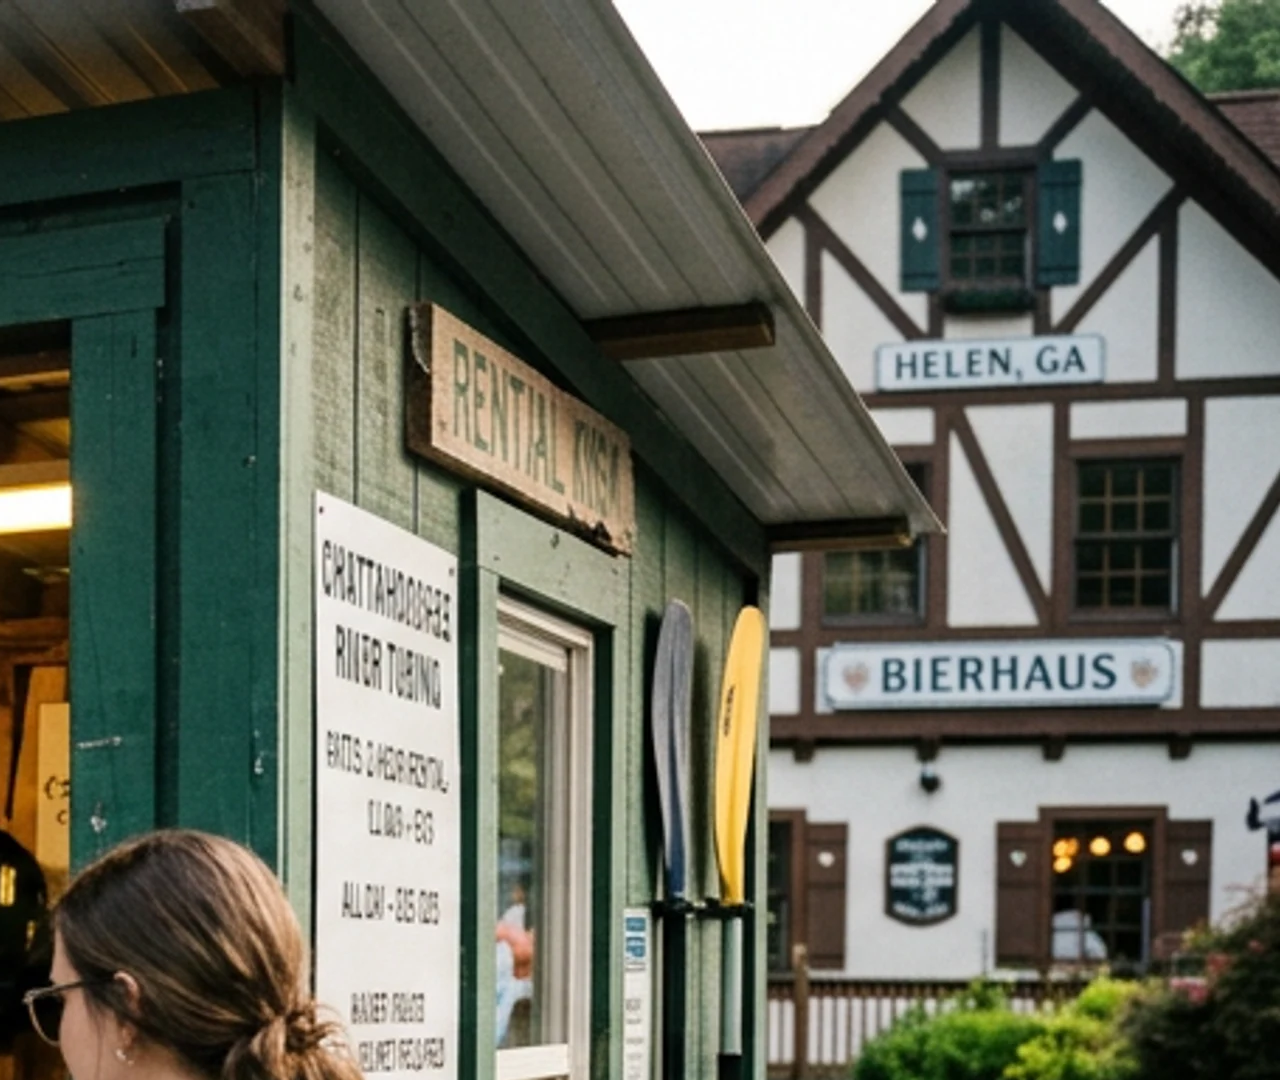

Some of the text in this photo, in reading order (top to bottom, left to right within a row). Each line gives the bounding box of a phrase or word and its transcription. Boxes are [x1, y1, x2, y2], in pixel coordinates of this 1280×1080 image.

[894, 344, 1087, 381] HELEN, GA
[880, 653, 1117, 693] BIERHAUS
